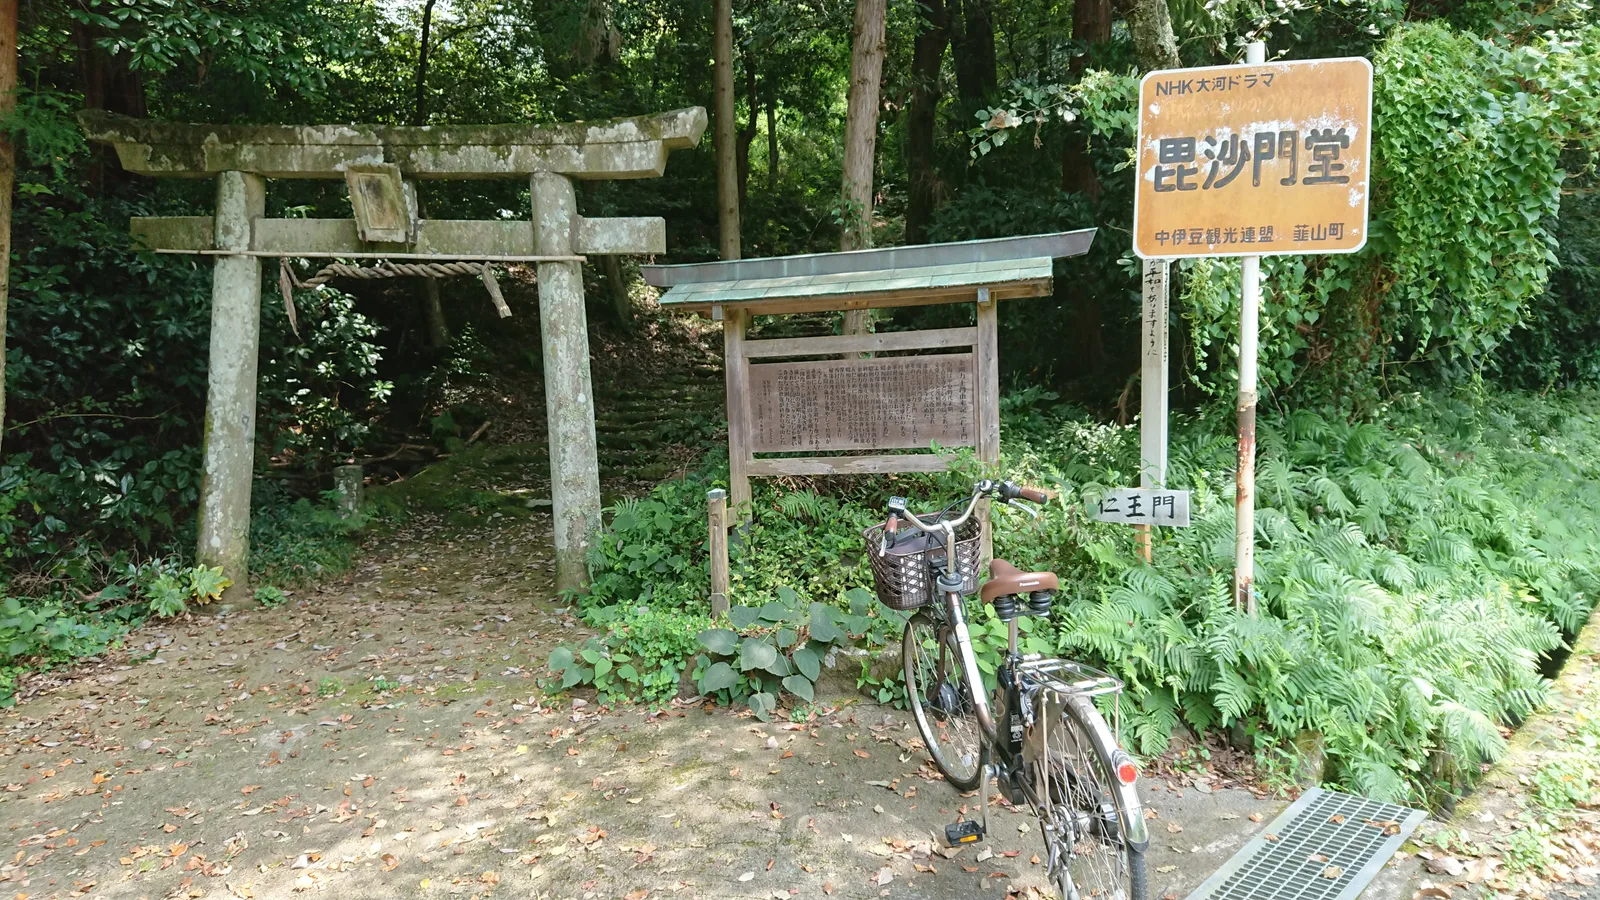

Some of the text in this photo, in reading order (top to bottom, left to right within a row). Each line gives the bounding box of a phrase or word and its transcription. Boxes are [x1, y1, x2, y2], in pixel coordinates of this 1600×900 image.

[1155, 72, 1275, 97] NHK大河ドラマ
[1153, 127, 1351, 193] 毘沙門堂
[1154, 222, 1345, 246] 中伊豆観光連盟 韮山町
[1144, 258, 1161, 356] が平和でありますように
[1097, 493, 1176, 519] 仁王門
